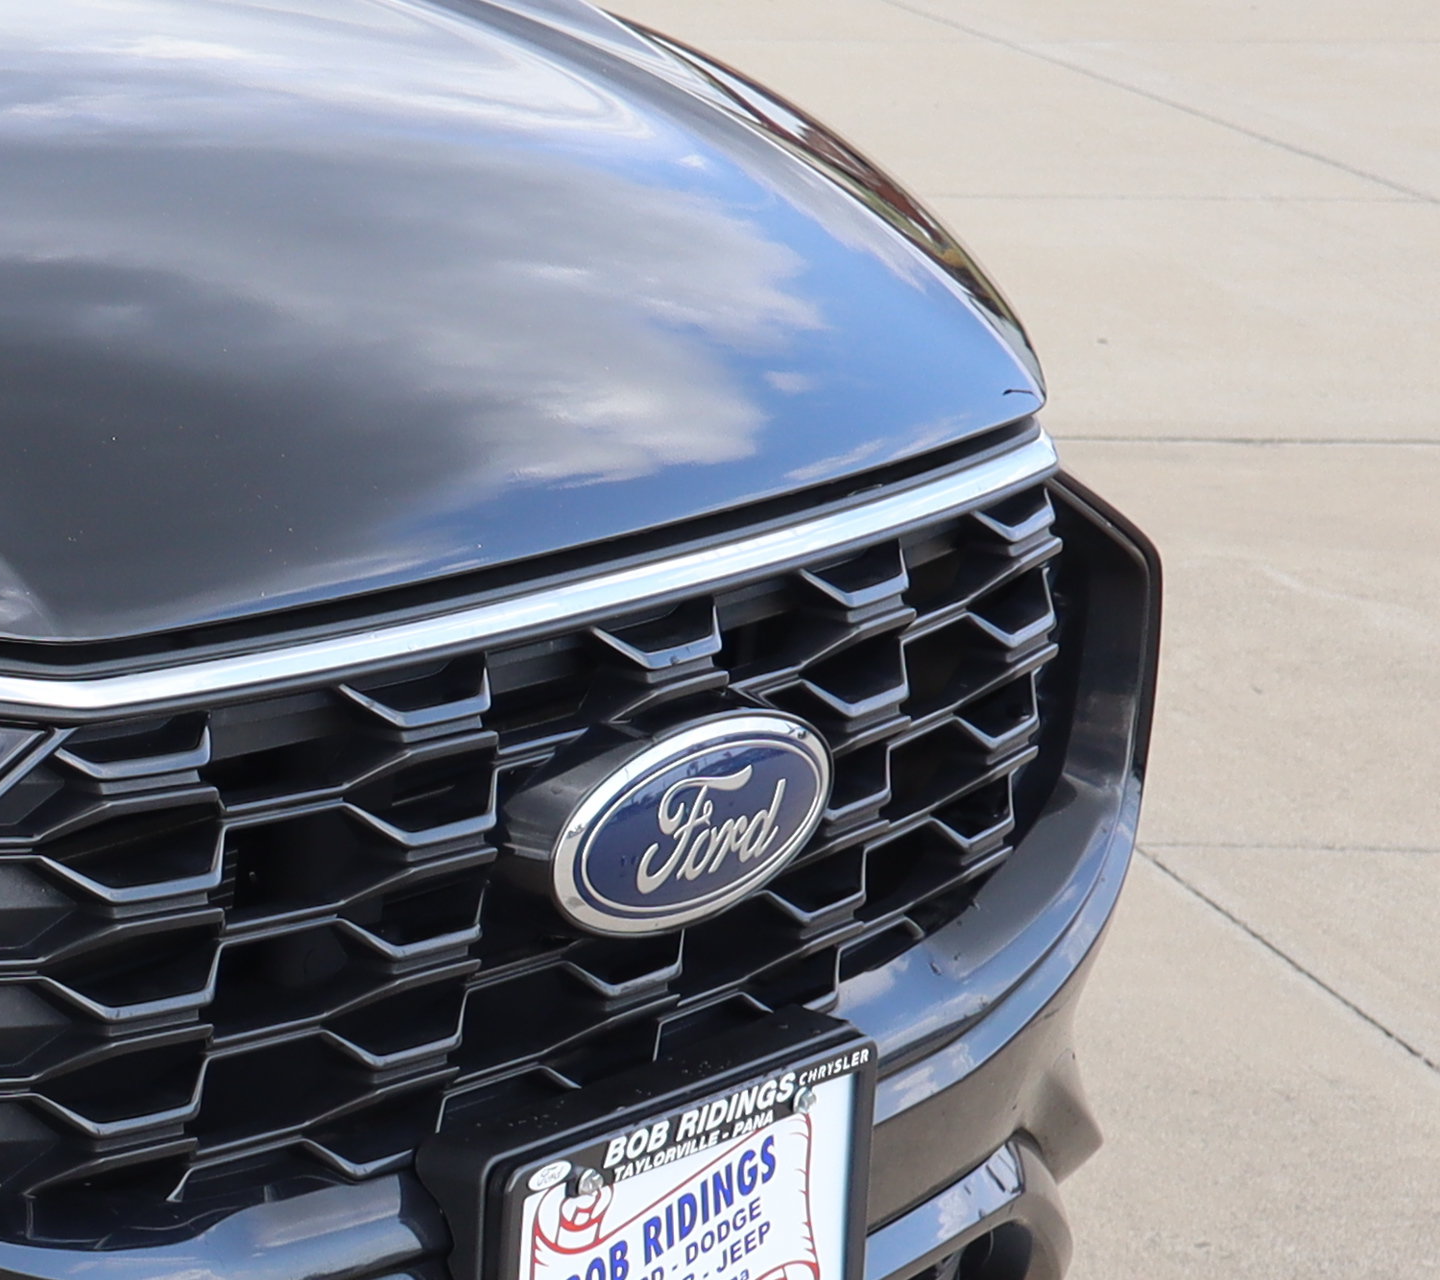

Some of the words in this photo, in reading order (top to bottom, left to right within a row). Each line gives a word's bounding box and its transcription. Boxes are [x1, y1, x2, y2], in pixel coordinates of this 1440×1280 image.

[636, 763, 787, 895] Ford
[603, 1119, 671, 1169] BOB
[675, 1072, 796, 1142] RIDINGS
[798, 1048, 870, 1087] CHRYSLER
[613, 1130, 720, 1183] TAYLORVILLE
[731, 1109, 775, 1139] PANA
[642, 1134, 777, 1266] RIDINGS
[685, 1196, 762, 1266] DODGE
[716, 1221, 771, 1274] JEEP
